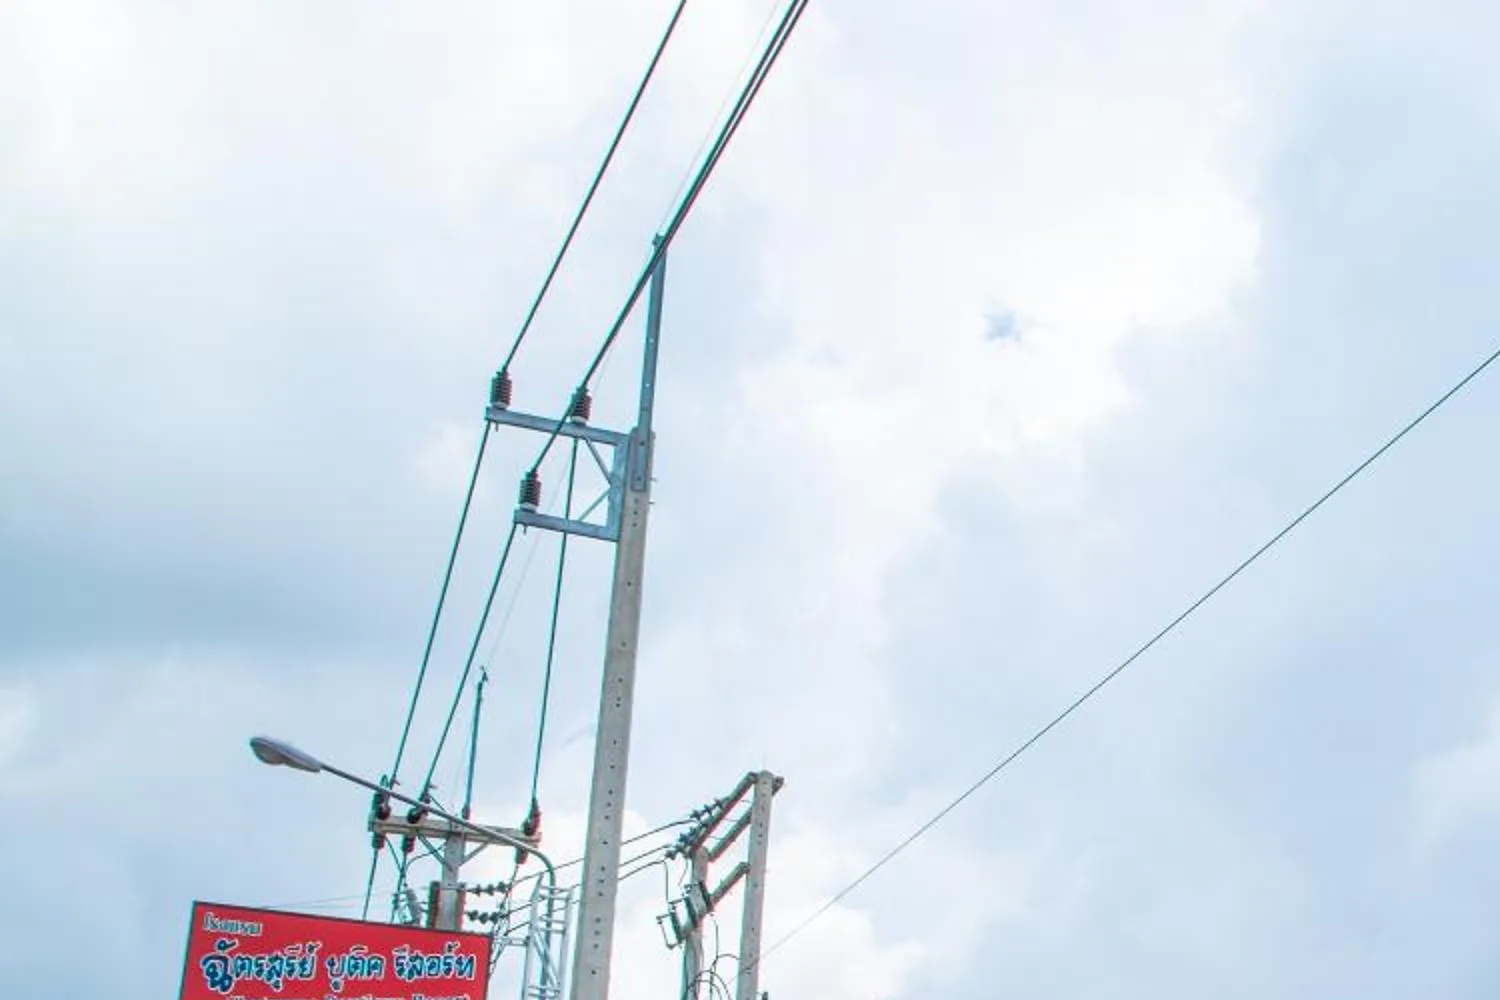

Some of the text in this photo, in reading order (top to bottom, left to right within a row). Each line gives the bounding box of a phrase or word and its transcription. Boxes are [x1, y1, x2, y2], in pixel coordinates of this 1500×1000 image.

[325, 944, 385, 992] บูติค
[392, 941, 476, 982] รีสอร์ท
